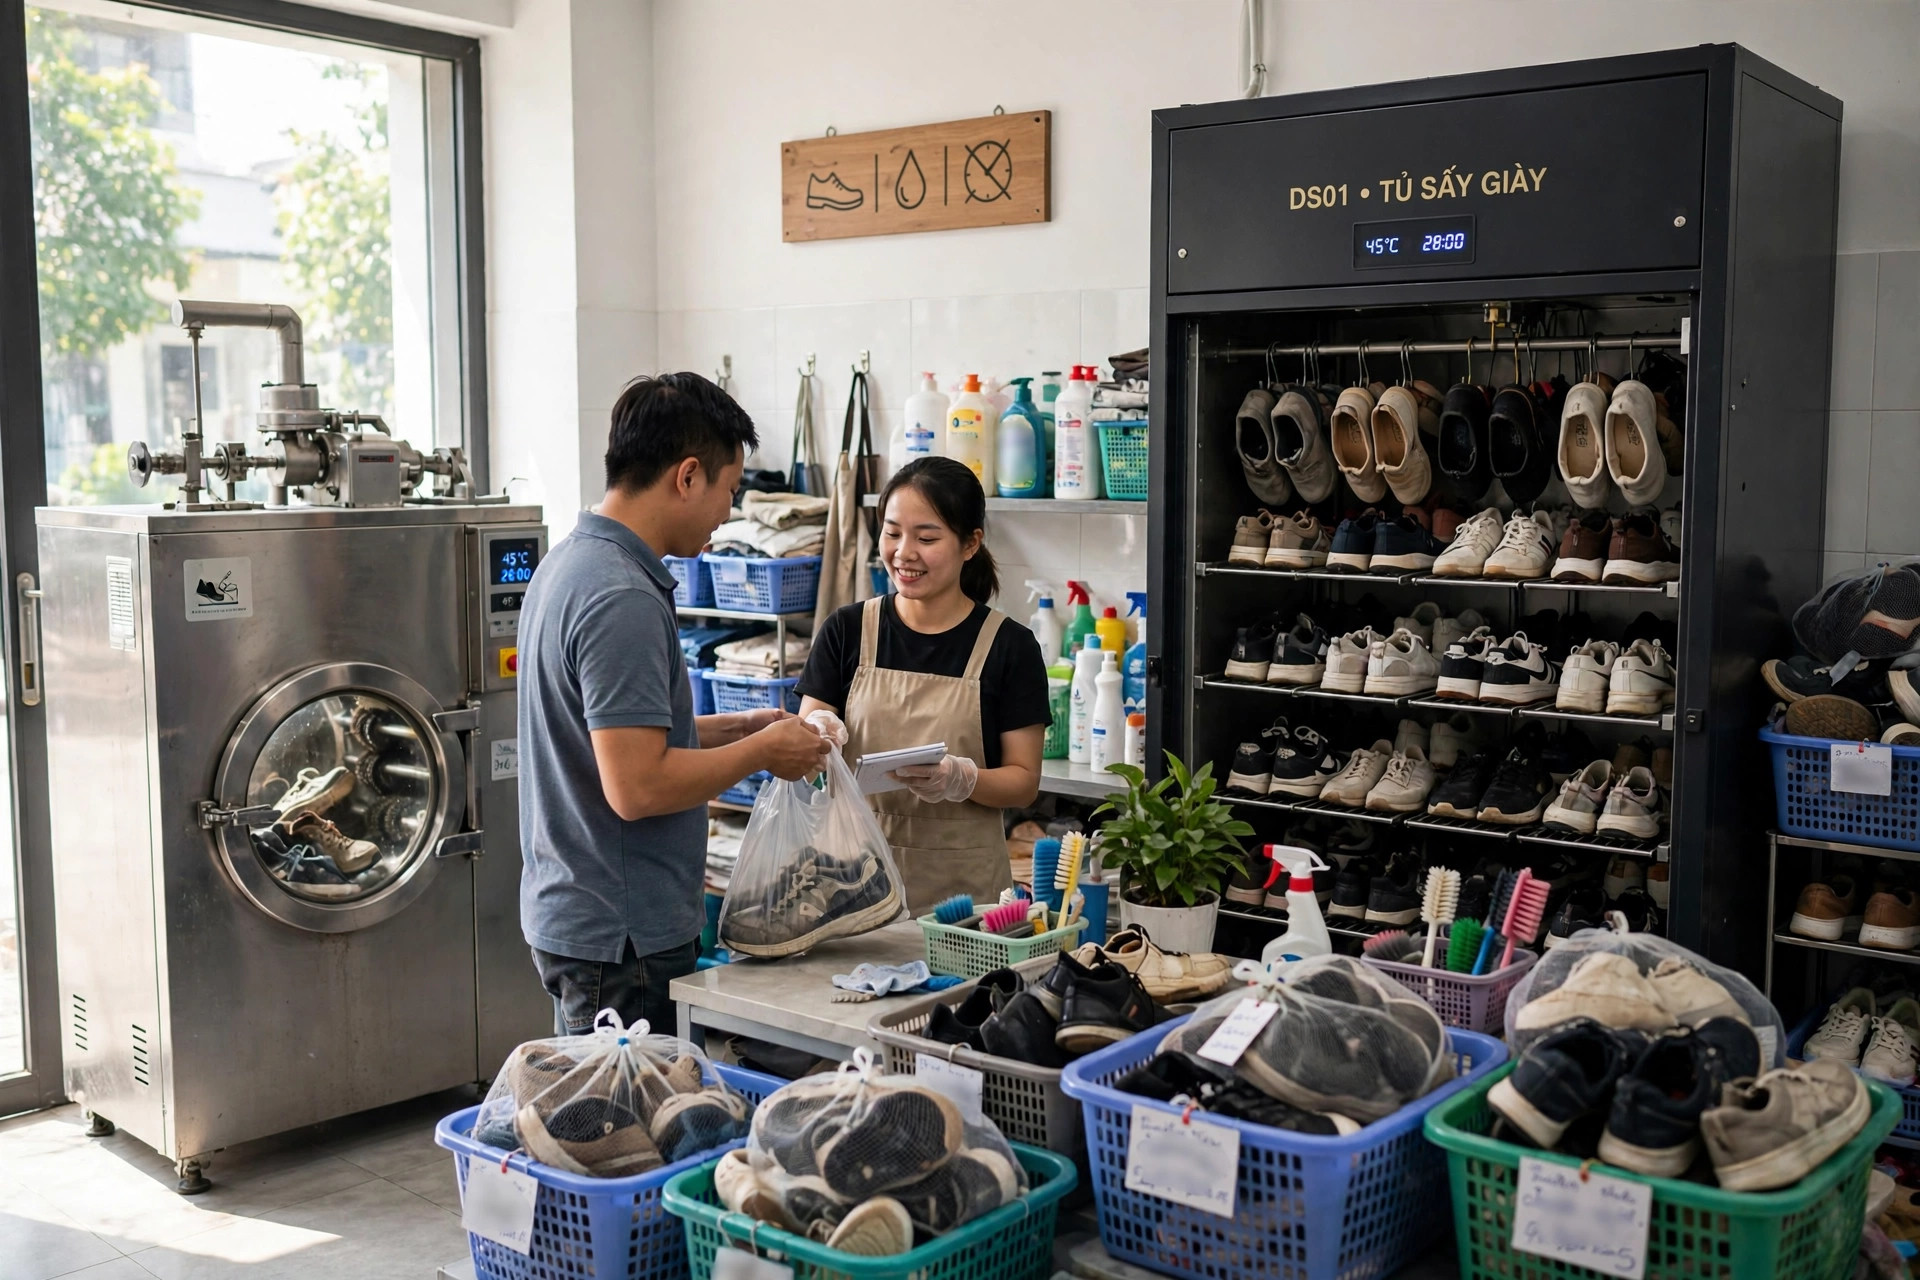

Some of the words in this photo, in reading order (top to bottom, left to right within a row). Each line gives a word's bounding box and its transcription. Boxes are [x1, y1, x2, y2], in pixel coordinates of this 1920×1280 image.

[1290, 184, 1348, 210] DS01
[1379, 170, 1413, 203] TỦ
[1420, 165, 1473, 200] SẤY
[1481, 163, 1548, 196] GIÀY
[1366, 237, 1400, 254] 45°C
[1422, 233, 1465, 252] 28:00
